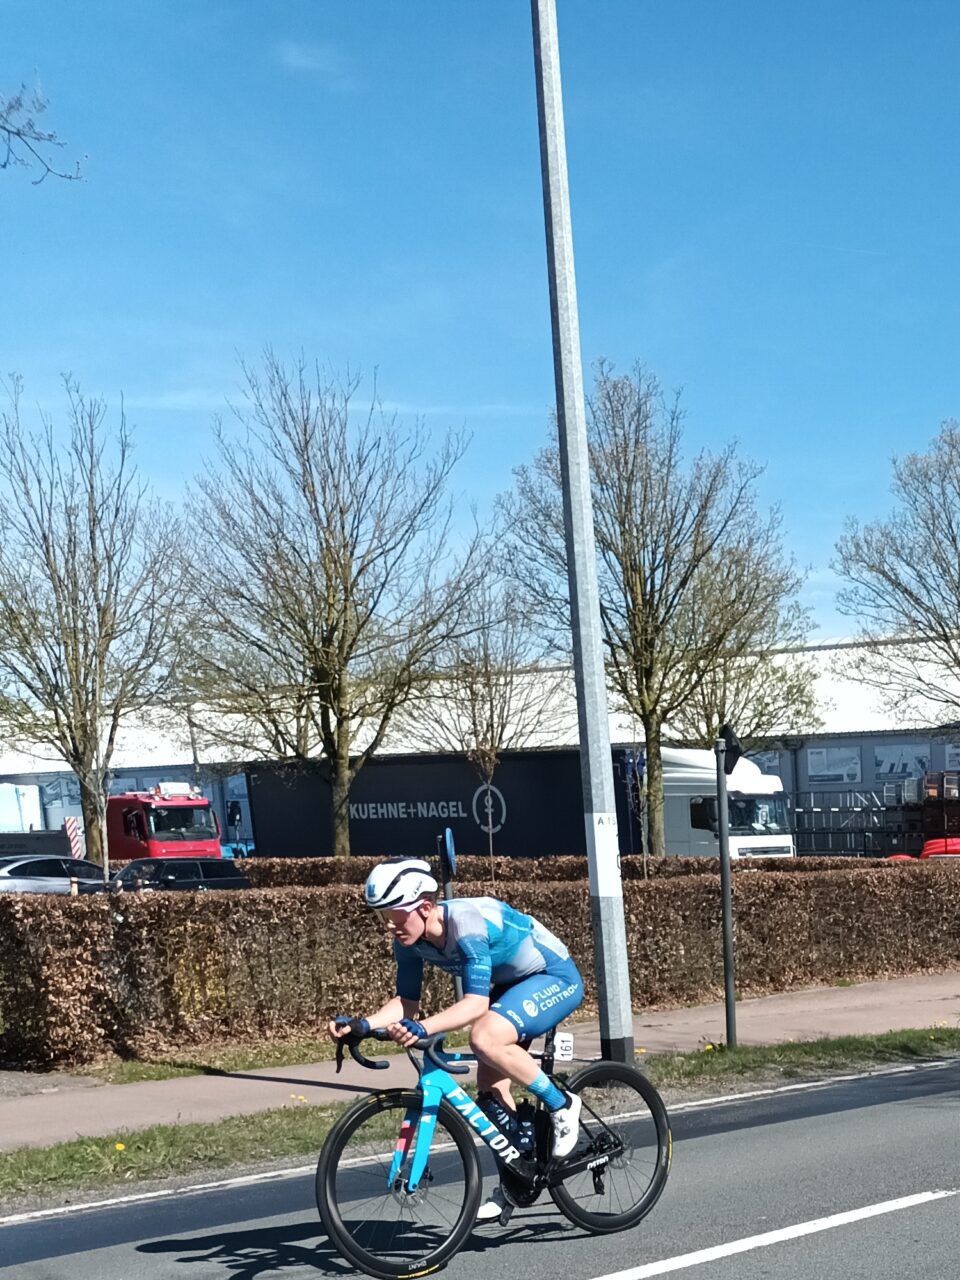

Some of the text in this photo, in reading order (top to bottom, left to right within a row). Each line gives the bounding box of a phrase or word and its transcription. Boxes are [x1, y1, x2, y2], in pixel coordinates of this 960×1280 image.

[350, 801, 468, 819] KUEHNE+NAGEL
[532, 983, 560, 1002] FLUID
[539, 983, 578, 1012] CONTROL
[560, 1039, 572, 1058] 161
[446, 1087, 521, 1164] FACTOR
